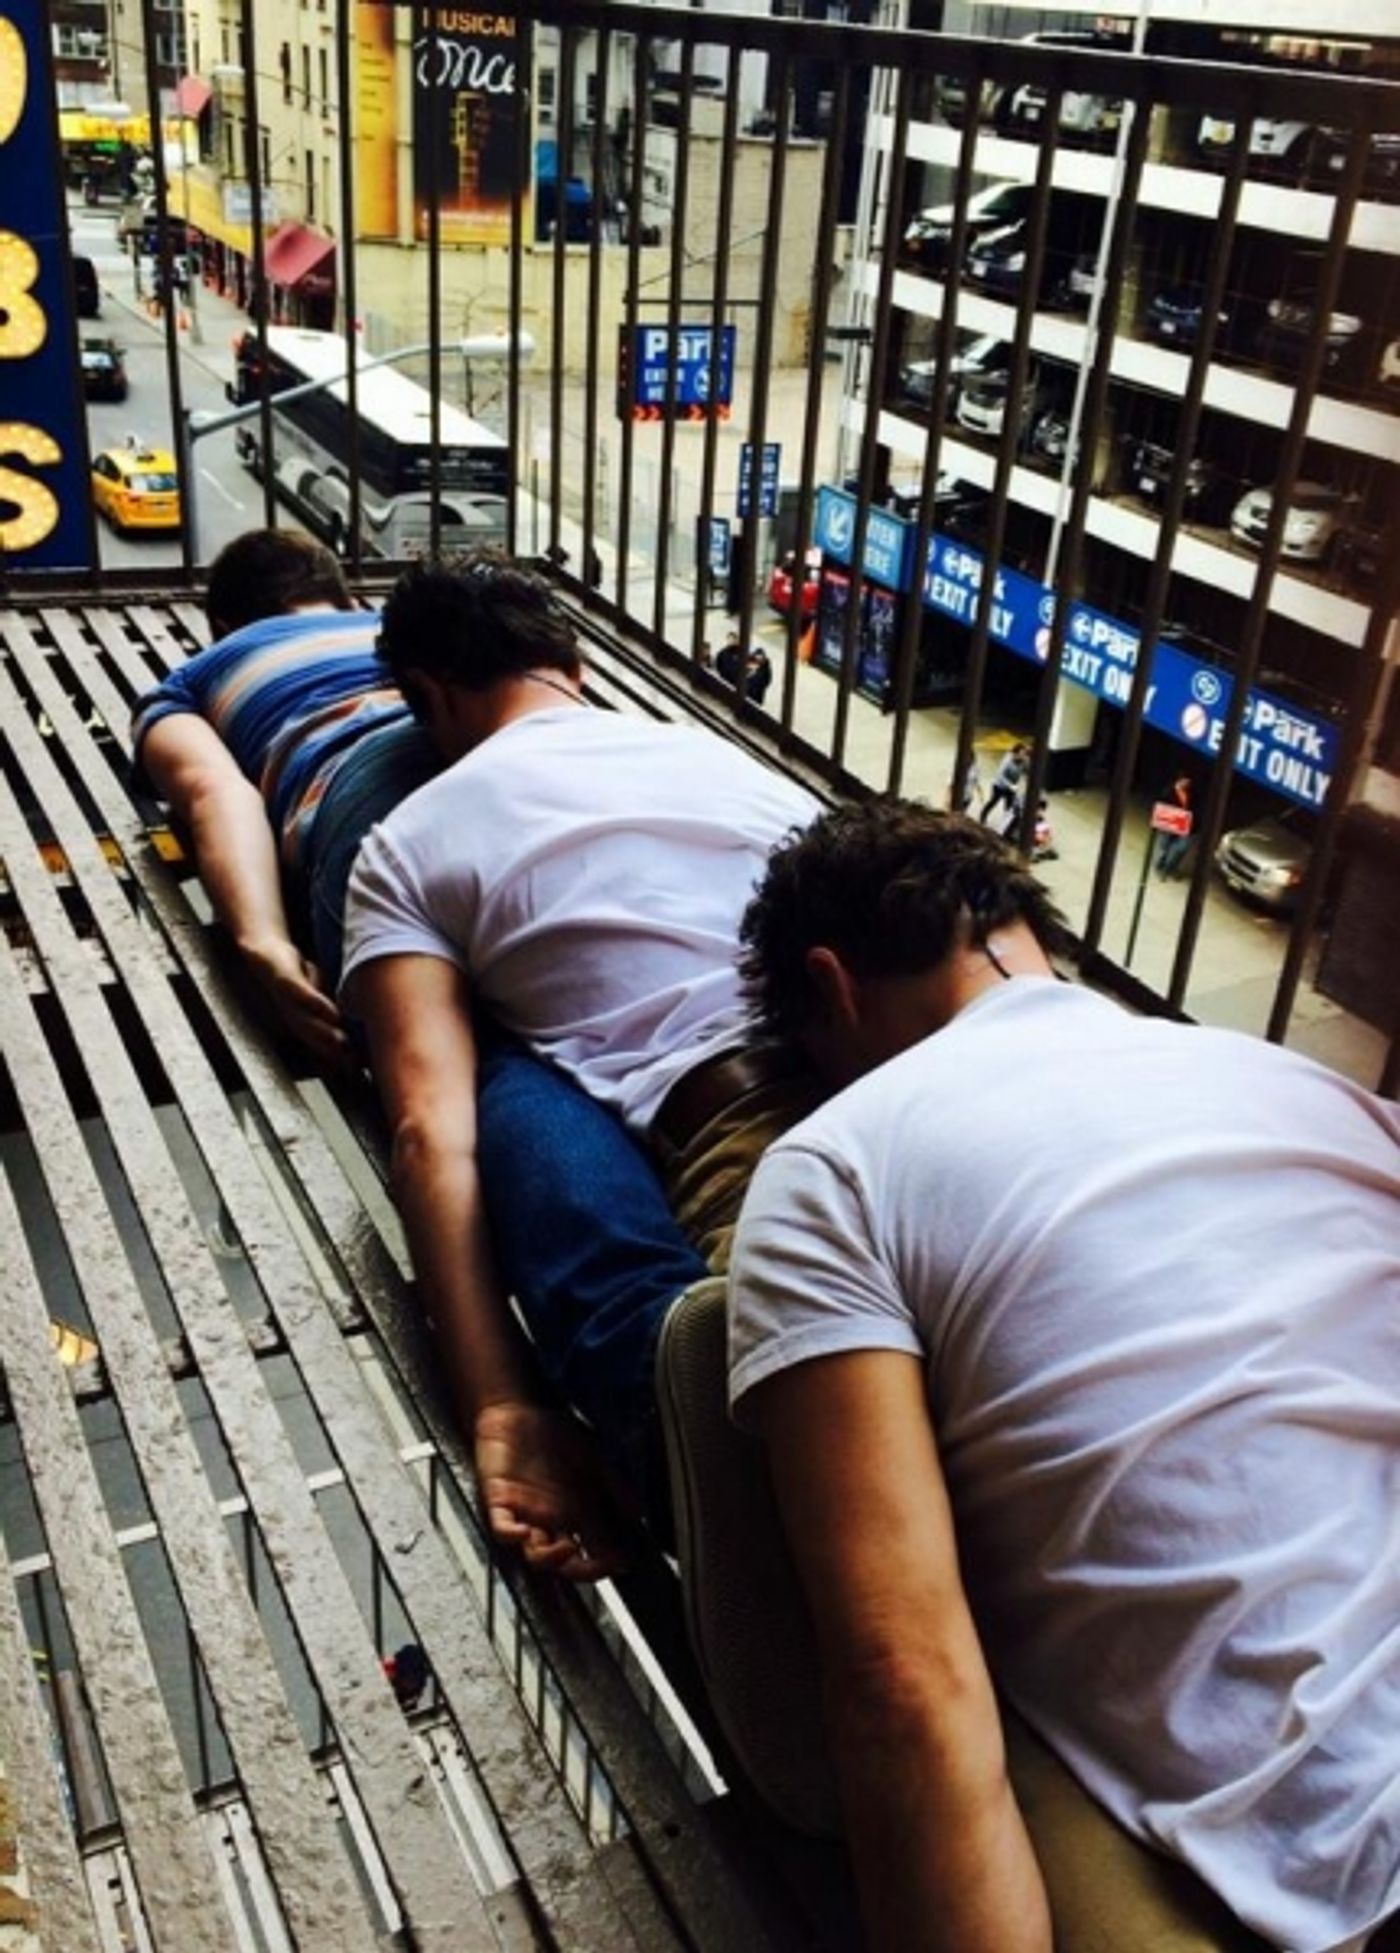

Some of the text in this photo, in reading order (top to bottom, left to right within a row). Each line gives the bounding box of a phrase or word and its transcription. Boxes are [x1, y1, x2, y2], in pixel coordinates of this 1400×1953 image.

[957, 553, 1006, 600] Pak
[930, 574, 1014, 639] EXIT LY
[1103, 665, 1157, 713] ON
[1253, 700, 1325, 759] Park
[1208, 719, 1331, 805] EIT ONLY
